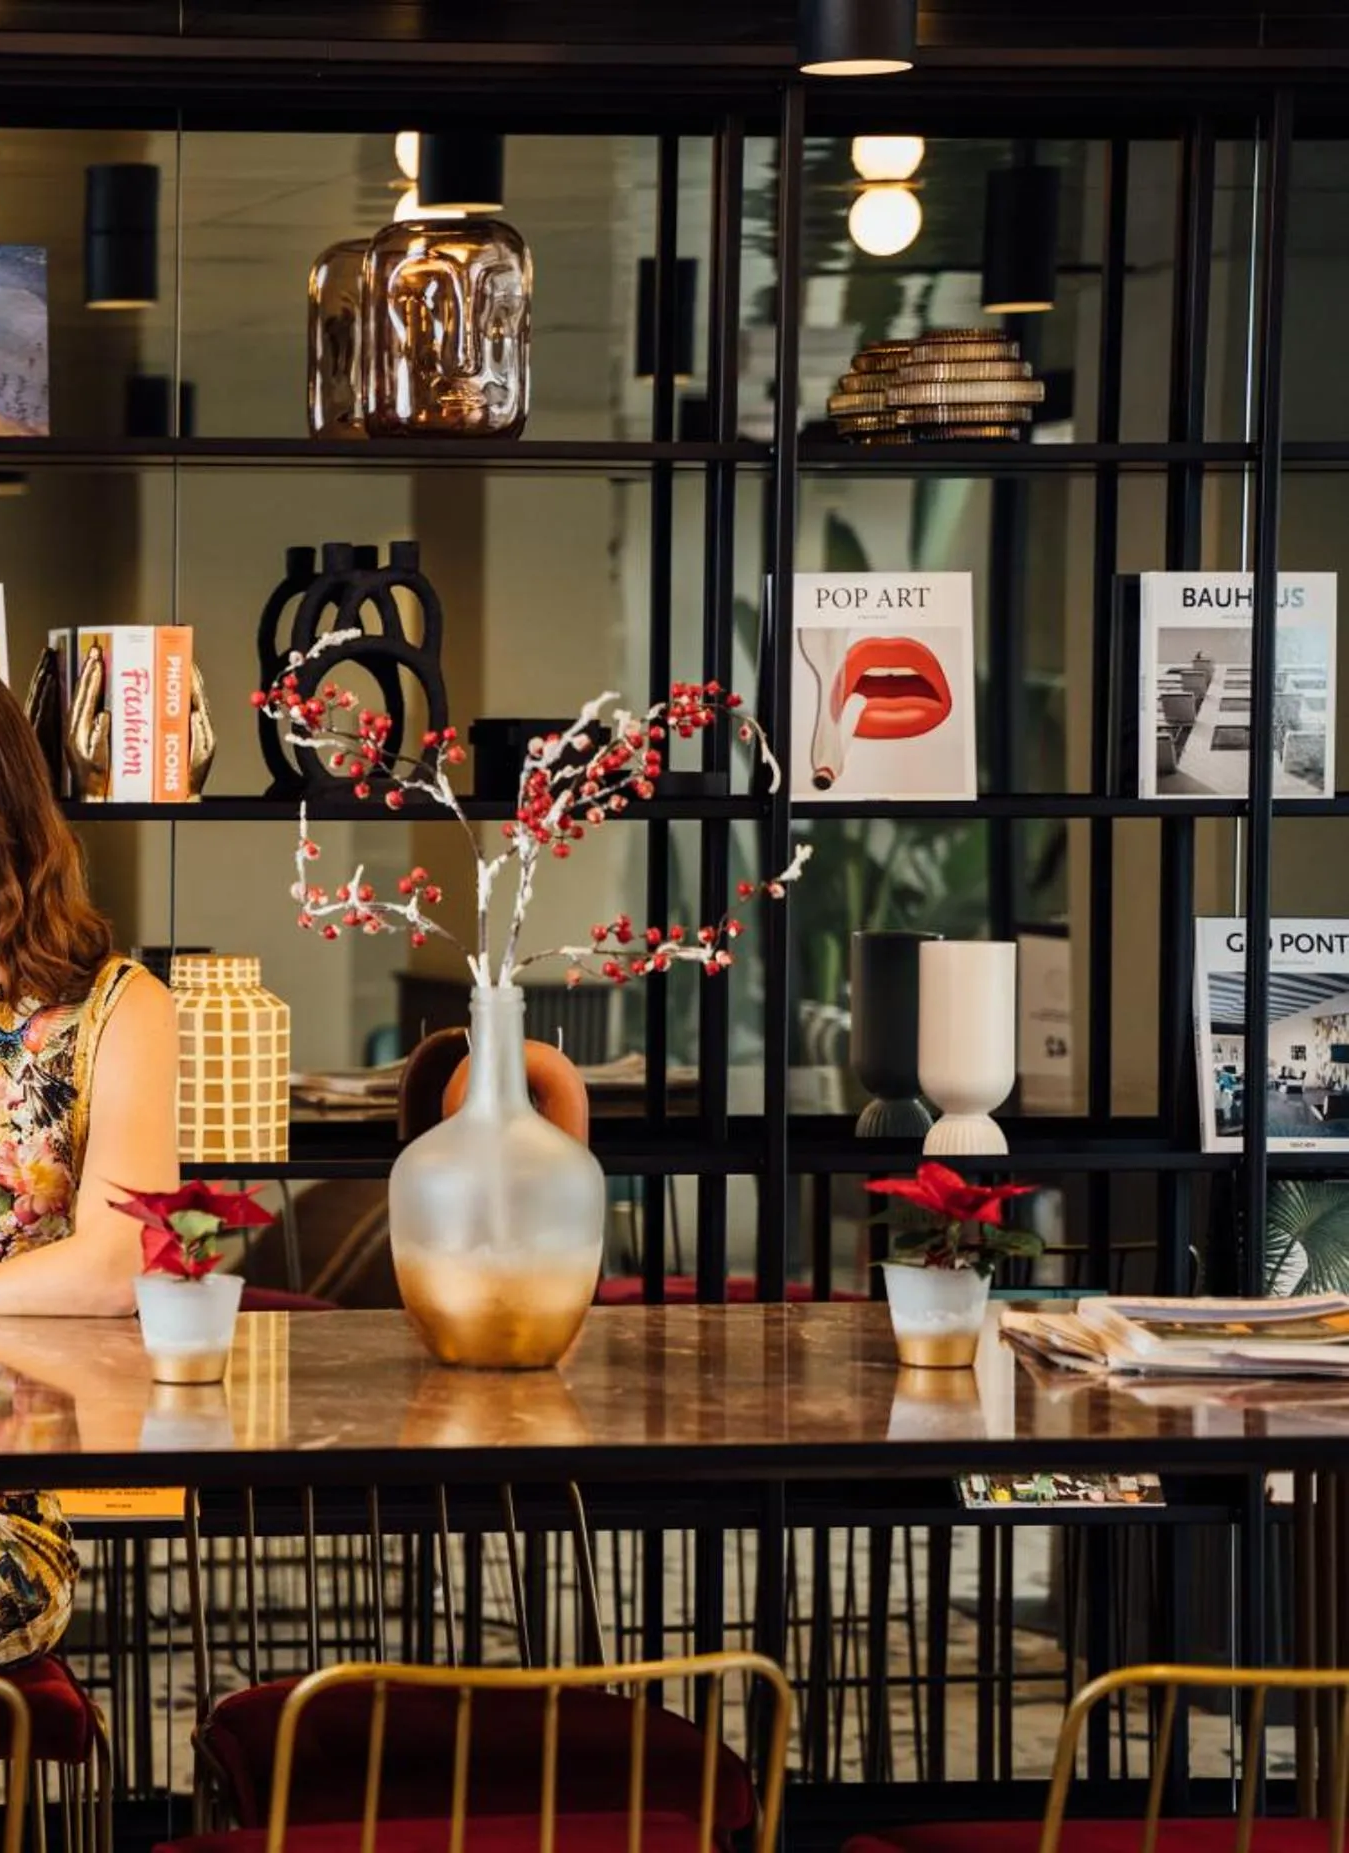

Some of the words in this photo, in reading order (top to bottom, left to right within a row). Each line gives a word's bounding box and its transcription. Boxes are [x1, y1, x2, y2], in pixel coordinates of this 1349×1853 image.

[816, 586, 868, 609] POP
[876, 586, 931, 608] ART
[1182, 586, 1305, 609] BAUHUS
[165, 655, 183, 718] PHOTO
[120, 667, 151, 777] Fashion
[164, 732, 181, 792] ICONS
